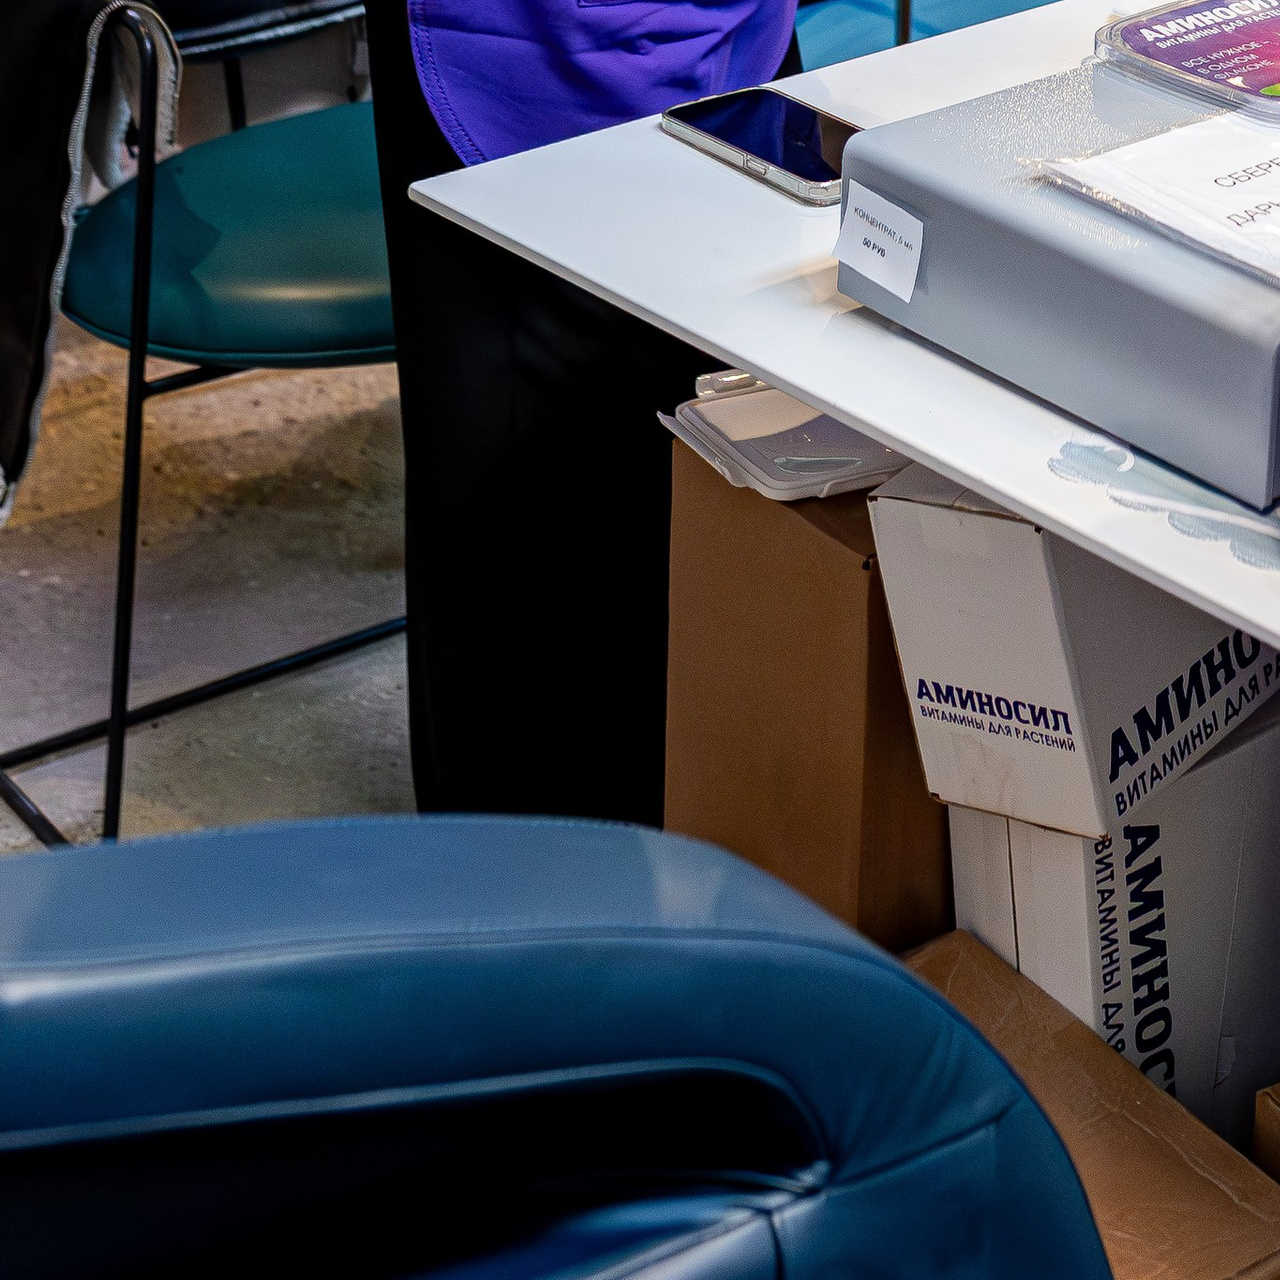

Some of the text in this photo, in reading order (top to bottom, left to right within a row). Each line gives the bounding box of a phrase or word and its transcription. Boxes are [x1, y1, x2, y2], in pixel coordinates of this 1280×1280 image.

[1155, 25, 1222, 50] ВИТАМИНЫ
[1221, 17, 1246, 34] ДЛЯ
[1208, 40, 1261, 62] НУЖНОЕ
[853, 205, 897, 243] КОНЦЕНТРАТ,
[871, 242, 887, 258] РУБ
[916, 677, 1074, 736] АМИНОСИЛ
[919, 705, 1077, 754] ВИТАМИНЫ ДЛЯ РАСТЕНИЙ
[1114, 705, 1220, 817] ВИТАМИНЫ
[1223, 676, 1262, 727] ДЛЯ
[1094, 834, 1122, 993] ВИТАМИНЫ
